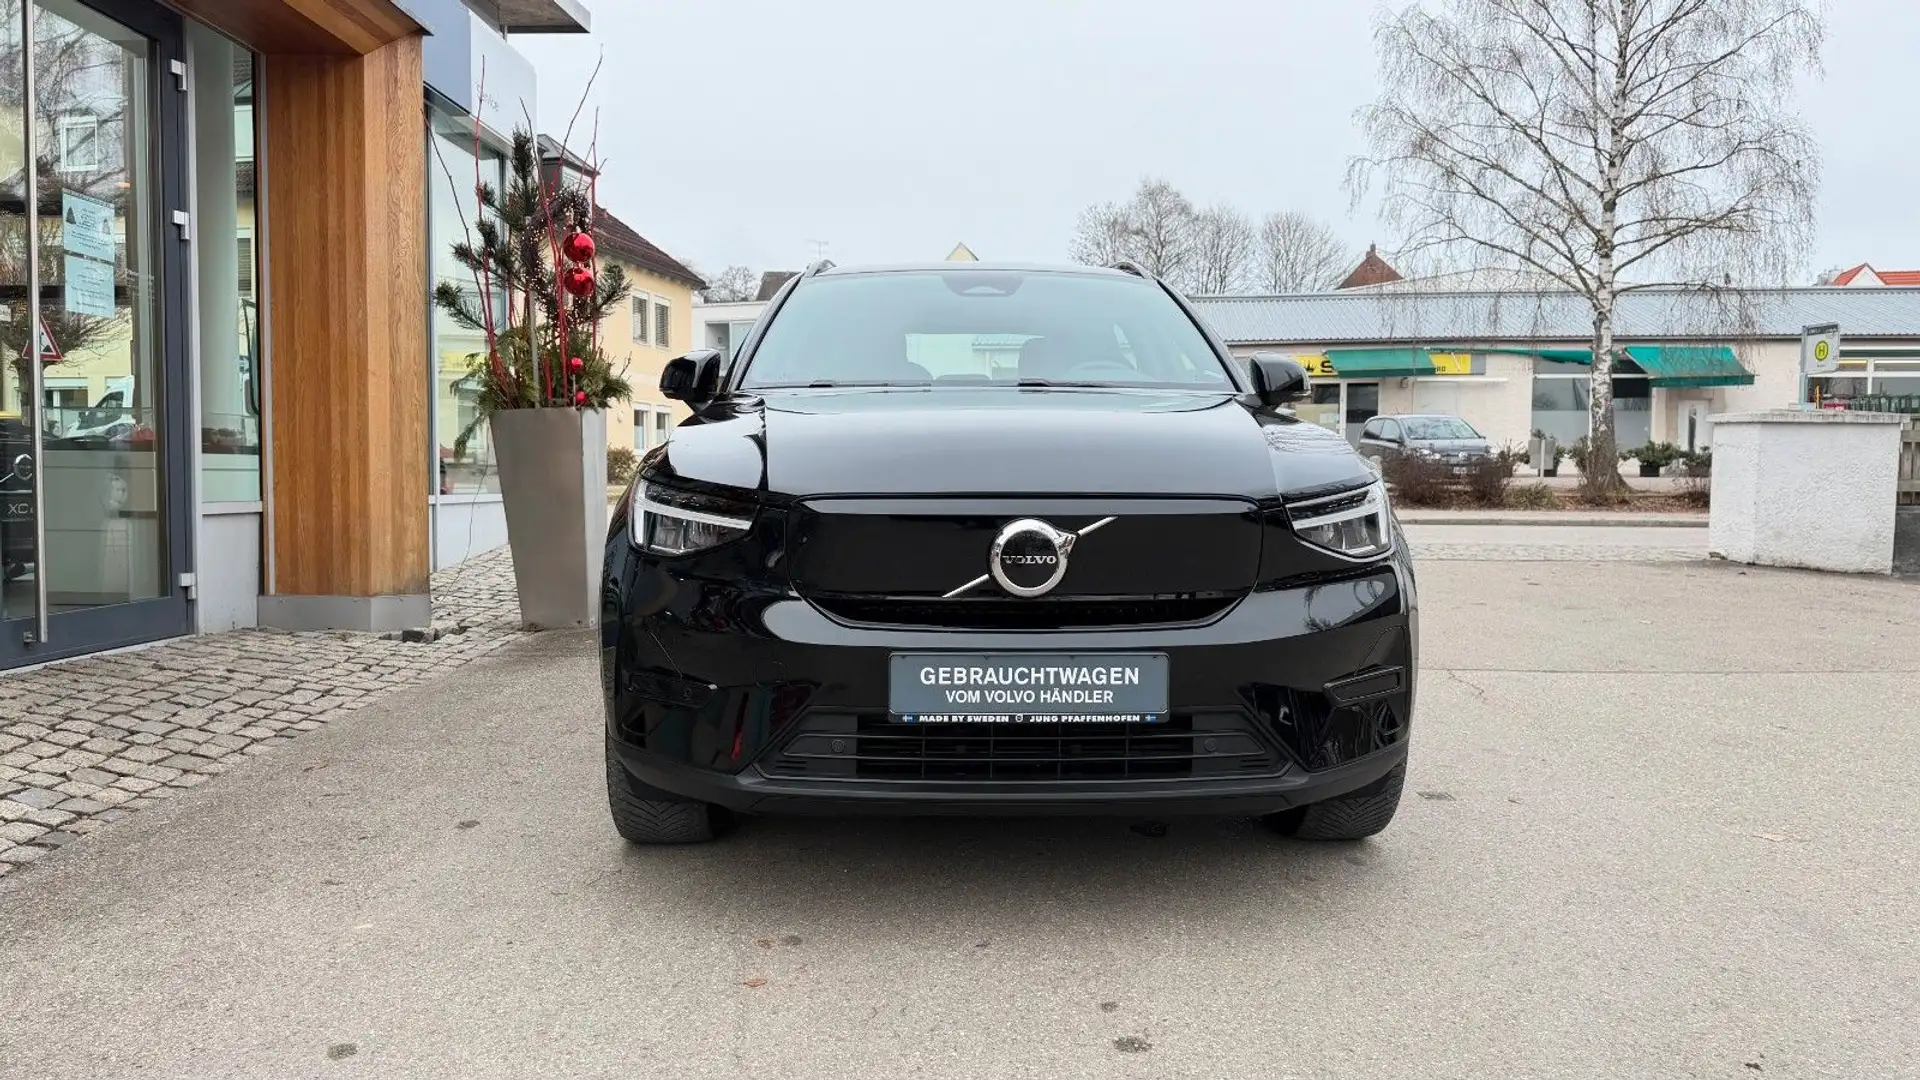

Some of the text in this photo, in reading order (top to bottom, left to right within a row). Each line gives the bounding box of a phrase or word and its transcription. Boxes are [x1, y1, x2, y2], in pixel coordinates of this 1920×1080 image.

[1002, 555, 1058, 564] VOLVO
[919, 667, 1140, 685] GEBRAUCHTWAGEN
[945, 688, 1114, 704] VOM VOLVO HÄNDLER
[919, 714, 1141, 723] MADE BY SWEDEN JUNG PFAFFENHOFEN
